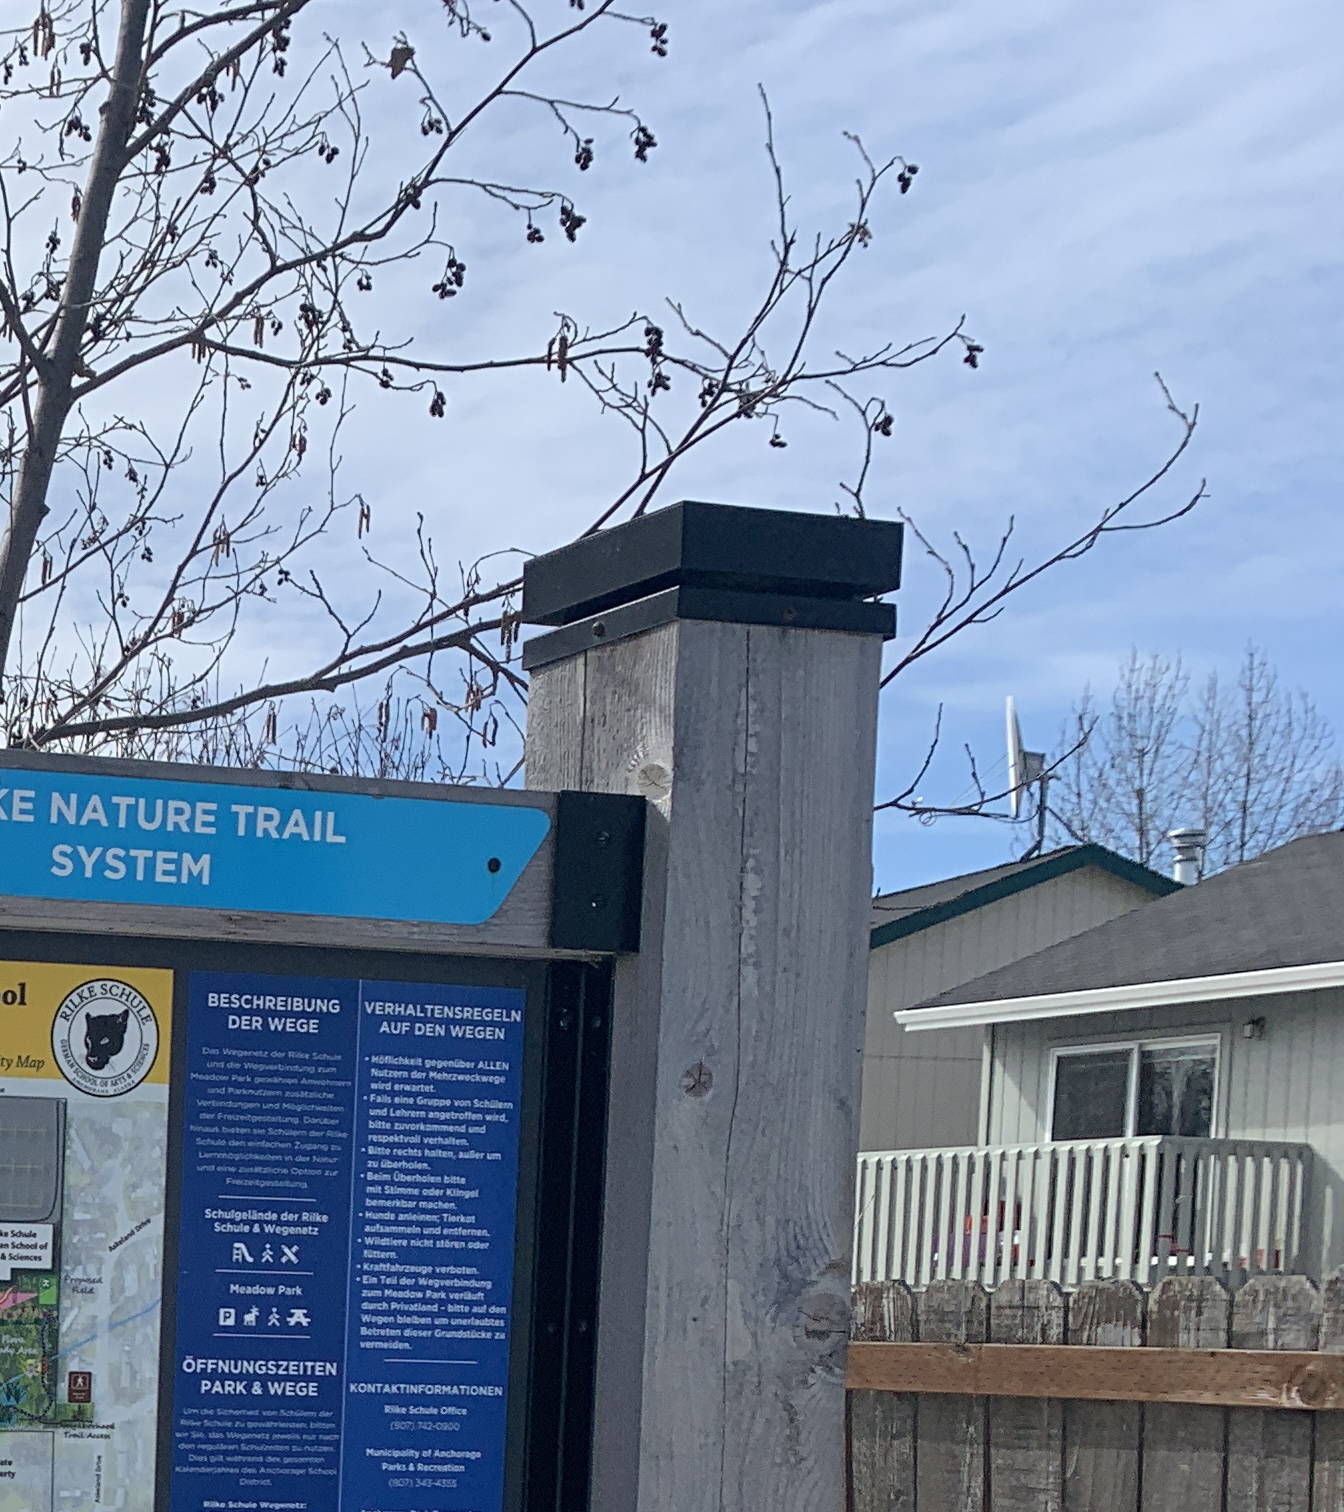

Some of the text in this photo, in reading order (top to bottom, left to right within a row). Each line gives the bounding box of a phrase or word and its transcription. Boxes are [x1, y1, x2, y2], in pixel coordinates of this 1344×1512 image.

[50, 794, 217, 833] NATURE
[231, 806, 346, 842] TRAIL
[51, 846, 210, 883] SYSTEM
[60, 983, 153, 1027] RILKE SCHULE
[208, 994, 340, 1012] BESCHREIBUNG
[364, 1002, 521, 1021] VERHALTENSREGELN
[228, 1016, 319, 1033] DER WEGE
[380, 1022, 505, 1039] AUF DEN WEGEN
[16, 1055, 45, 1072] Map
[371, 1056, 509, 1070] Höflichkeit gegenüber ALLEN
[371, 1069, 505, 1084] Nutzern der Mehrzweckwege
[371, 1081, 436, 1092] wird erwartet.
[370, 1094, 392, 1103] Falls
[394, 1096, 414, 1104] eine
[416, 1097, 451, 1107] Gruppe
[473, 1099, 513, 1109] Schülern
[369, 1108, 508, 1123] und Lehrern angetroffen wird,
[369, 1120, 486, 1134] bitte zuvorkommend und
[368, 1135, 469, 1146] respektvoll verhalten.
[205, 1209, 329, 1222] Schulgelände der Rilke
[11, 1230, 37, 1238] Schule
[214, 1222, 319, 1236] Schule & Wegenetz
[11, 1242, 38, 1250] School
[39, 1242, 48, 1250] of
[8, 1253, 42, 1261] Sciences
[230, 1285, 302, 1295] Meadow Park
[183, 1357, 337, 1375] ÖFFNUNGSZEITEN
[201, 1381, 318, 1396] PARK & WEGE
[350, 1384, 503, 1395] KONTAKTINFORMATIONEN
[384, 1405, 467, 1415] Rilke Schule Office
[366, 1449, 481, 1460] Municipality of Anchorage
[382, 1463, 465, 1472] Parks & Recreation
